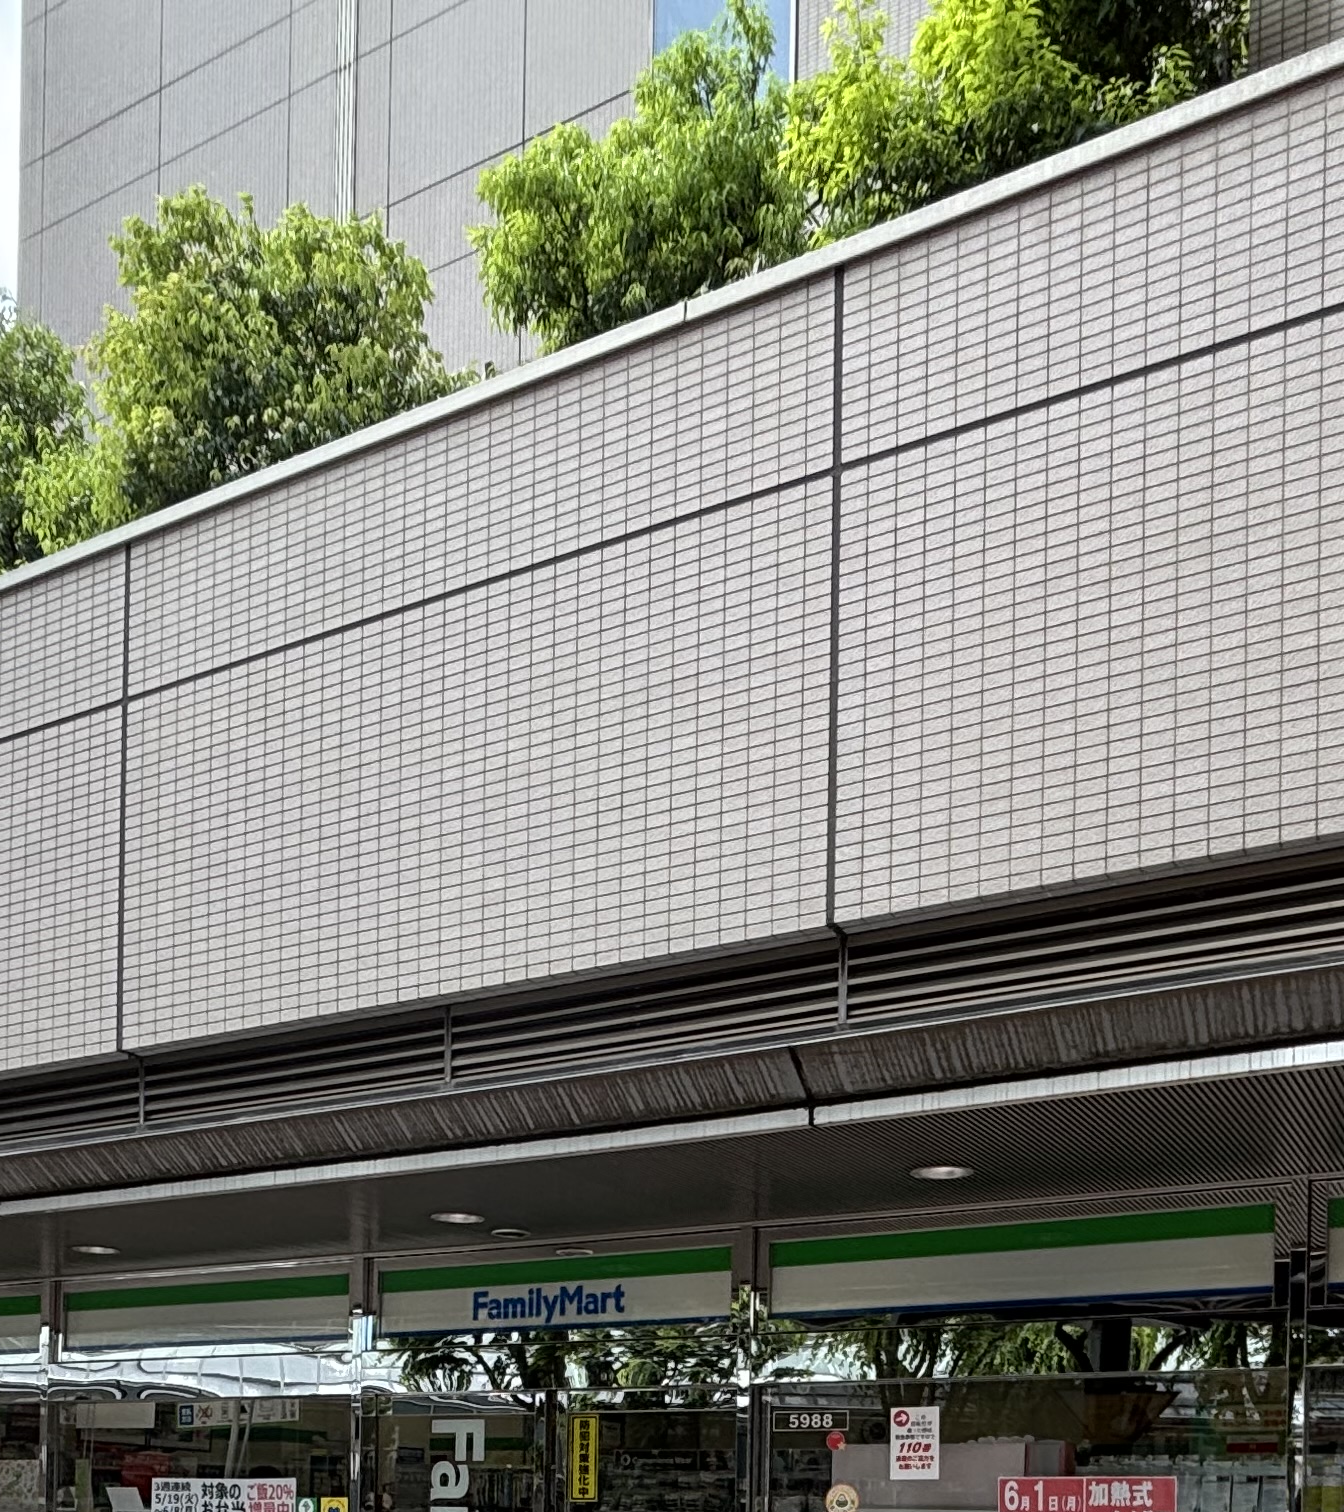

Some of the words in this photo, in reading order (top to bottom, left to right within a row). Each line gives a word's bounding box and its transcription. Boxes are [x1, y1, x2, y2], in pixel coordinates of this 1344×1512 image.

[472, 1283, 626, 1323] FamilyMart
[789, 1413, 834, 1429] 5988
[154, 1493, 199, 1506] 5/19(火)
[200, 1481, 242, 1500] 対象の
[246, 1483, 294, 1501] ご飯20%
[1003, 1479, 1082, 1512] 6月1日(月)
[1088, 1480, 1154, 1508] 加熱式
